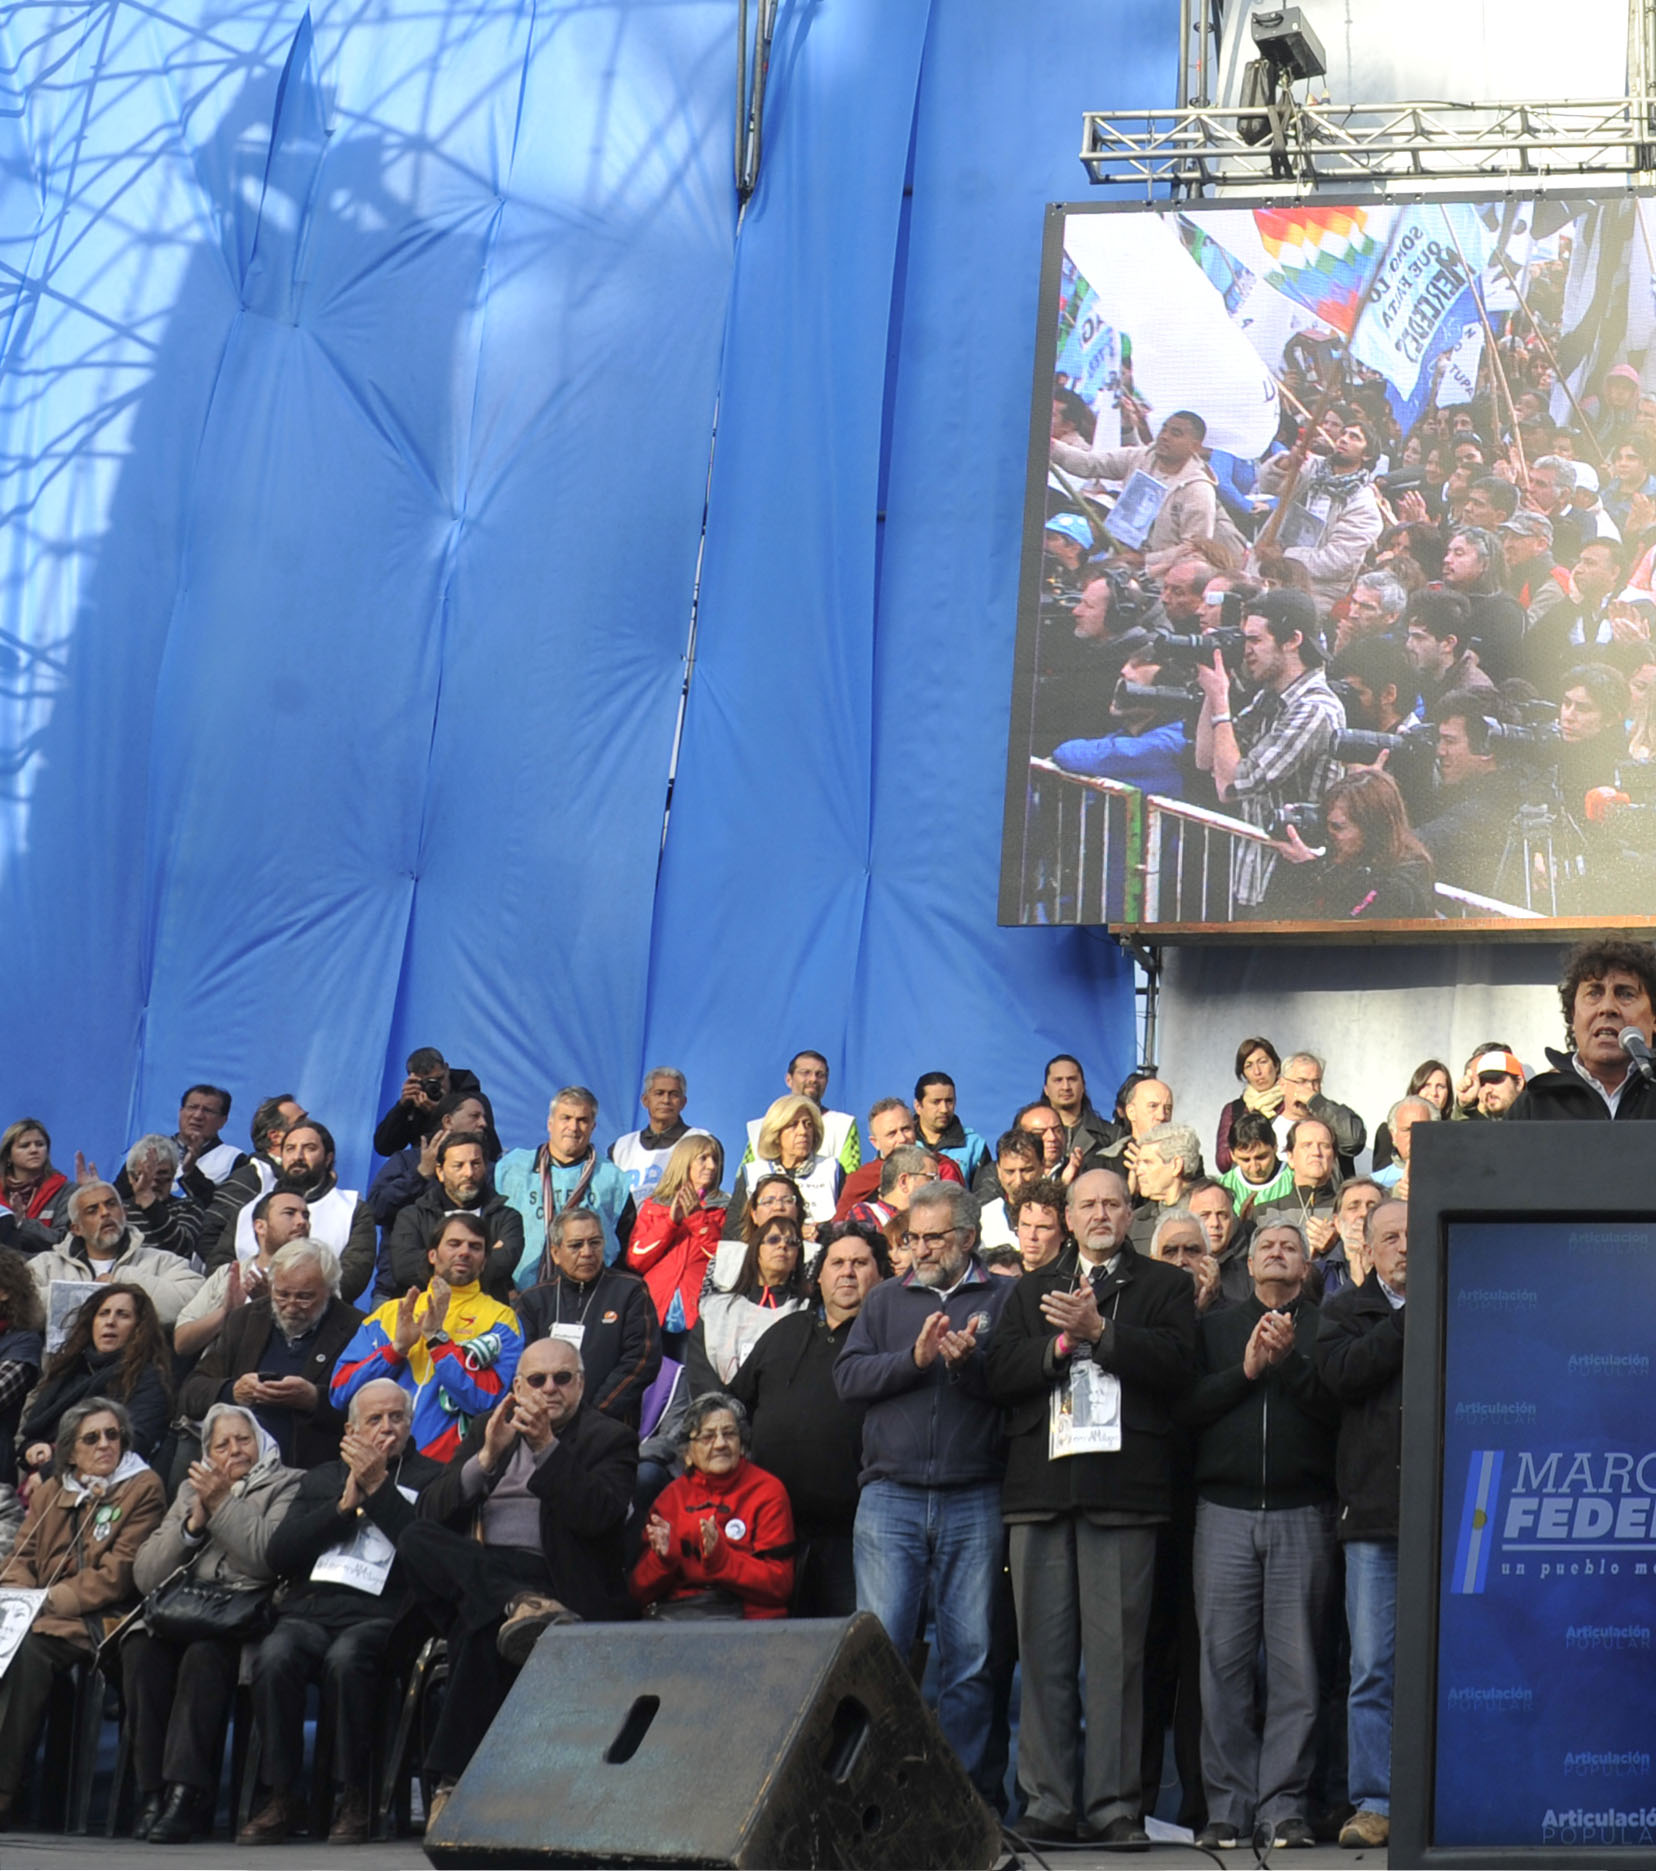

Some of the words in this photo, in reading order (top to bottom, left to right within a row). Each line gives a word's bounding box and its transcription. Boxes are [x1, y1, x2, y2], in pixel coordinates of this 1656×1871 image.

[1568, 1231, 1649, 1244] Articulación
[1457, 1288, 1537, 1302] Articulación
[1568, 1353, 1650, 1367] Articulación
[1455, 1401, 1536, 1415] Articulación
[1501, 1561, 1526, 1575] un
[1540, 1558, 1619, 1579] pueblo
[1566, 1624, 1651, 1639] Articulación
[1448, 1686, 1533, 1701] Articulación
[1564, 1750, 1651, 1765] Articulación
